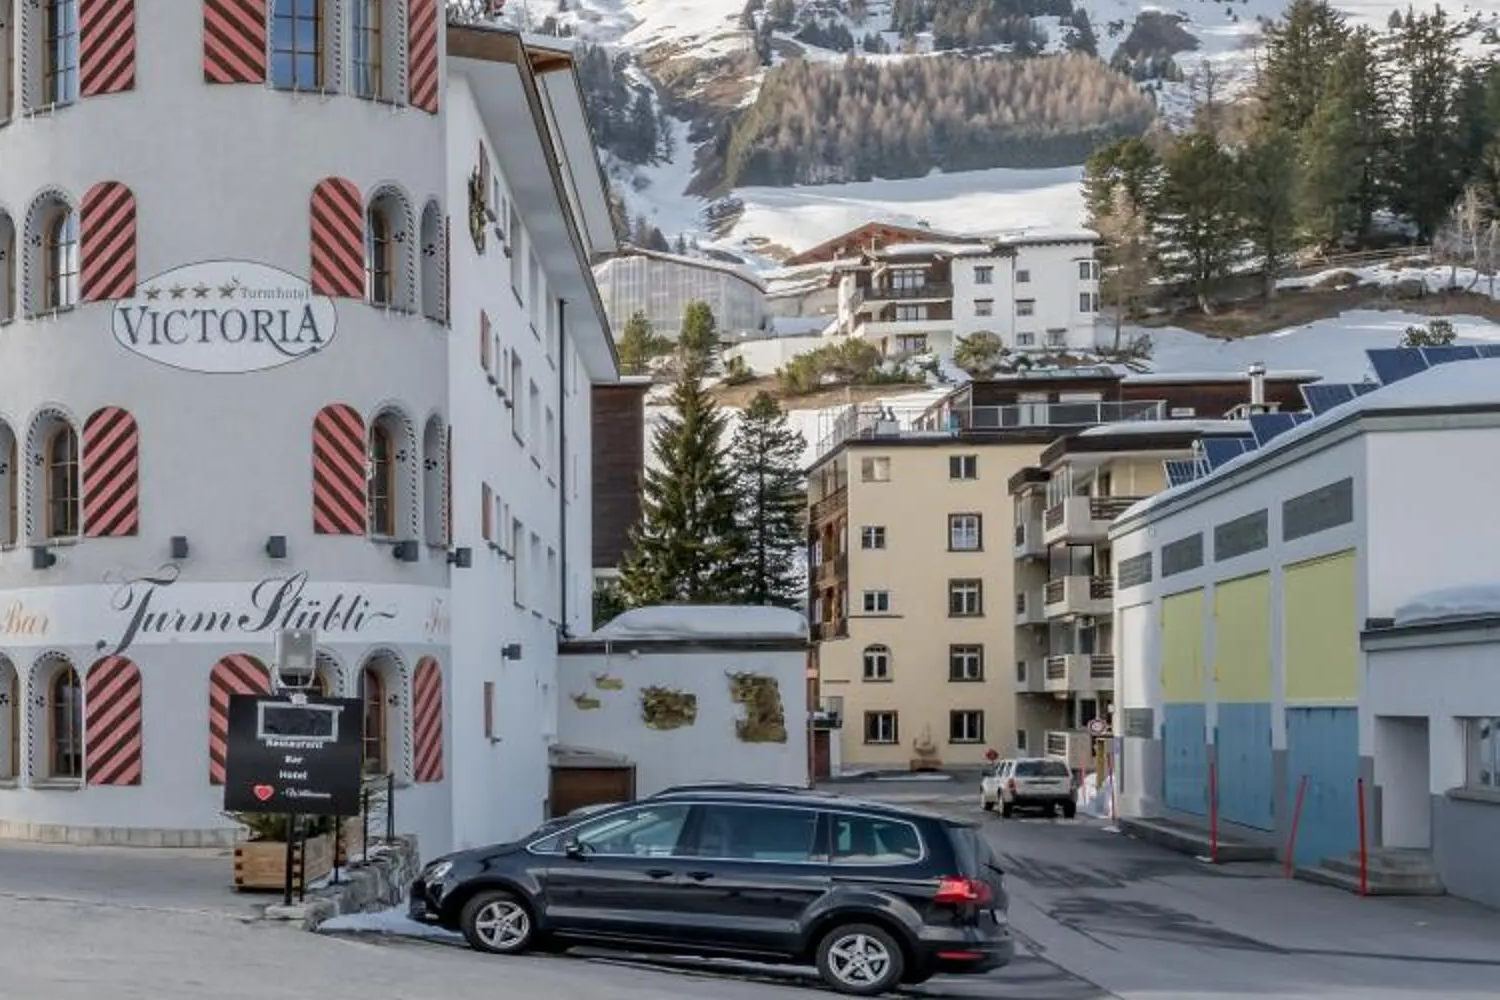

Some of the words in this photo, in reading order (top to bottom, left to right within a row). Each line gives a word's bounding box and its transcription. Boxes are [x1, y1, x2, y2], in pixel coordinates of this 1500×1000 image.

[240, 285, 309, 300] Turmhotel
[118, 302, 325, 357] VICTORIA
[265, 739, 324, 749] Restaurant
[284, 755, 303, 763] Bar
[279, 770, 308, 779] Hotel
